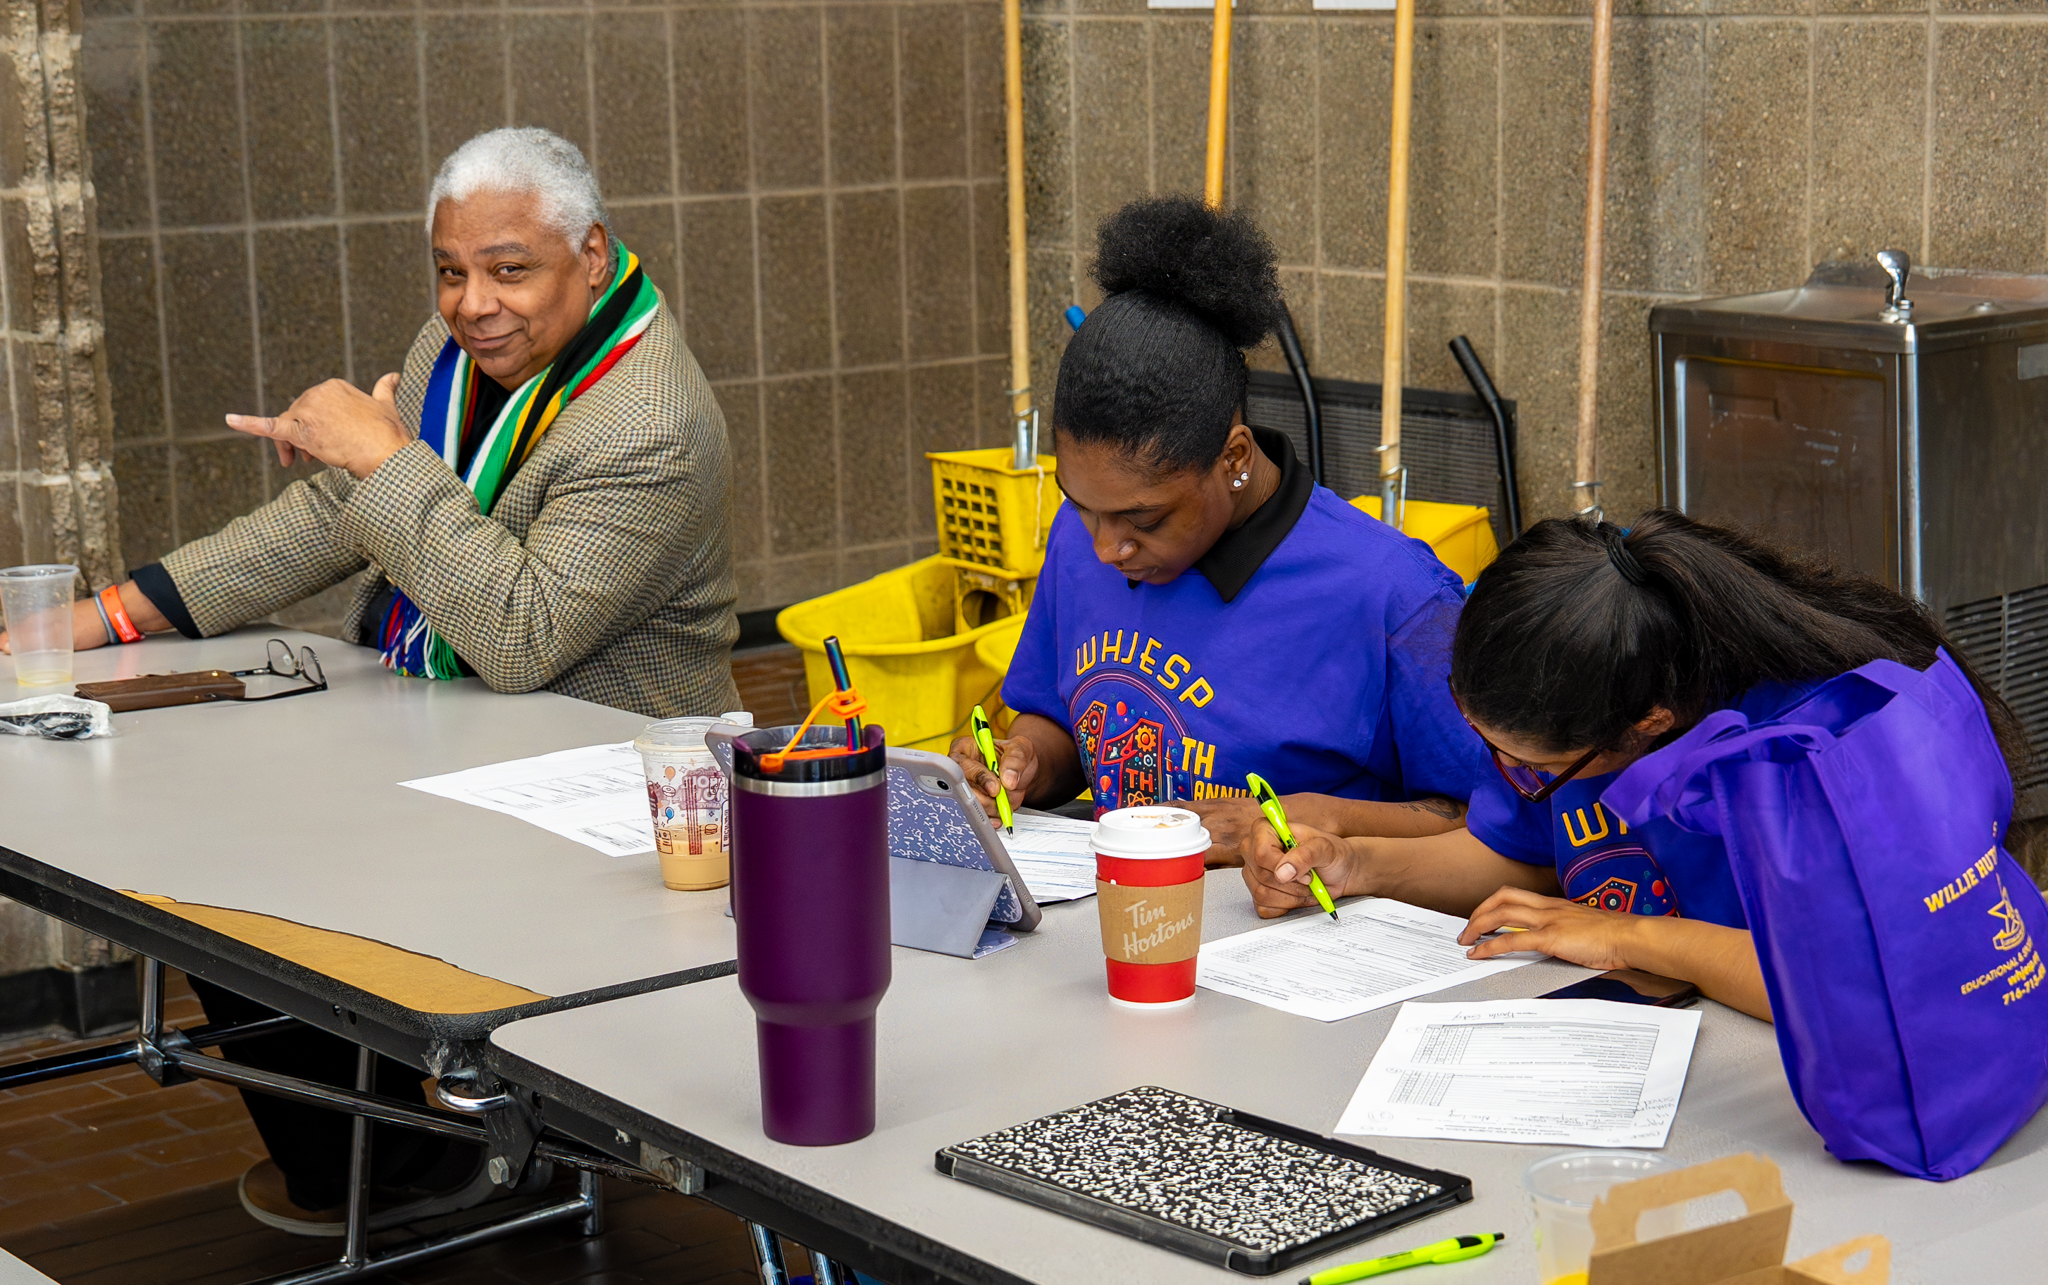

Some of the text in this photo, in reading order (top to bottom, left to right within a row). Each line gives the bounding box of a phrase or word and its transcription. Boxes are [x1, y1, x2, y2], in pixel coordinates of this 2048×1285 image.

[1076, 629, 1215, 708] WHJESP
[1182, 736, 1216, 779] TH
[1125, 767, 1154, 793] TH
[1923, 844, 1998, 914] WILLIE HUT
[1124, 899, 1167, 929] Tim
[1123, 912, 1195, 960] Hortons
[1960, 956, 2019, 995] EDUCATIONAL
